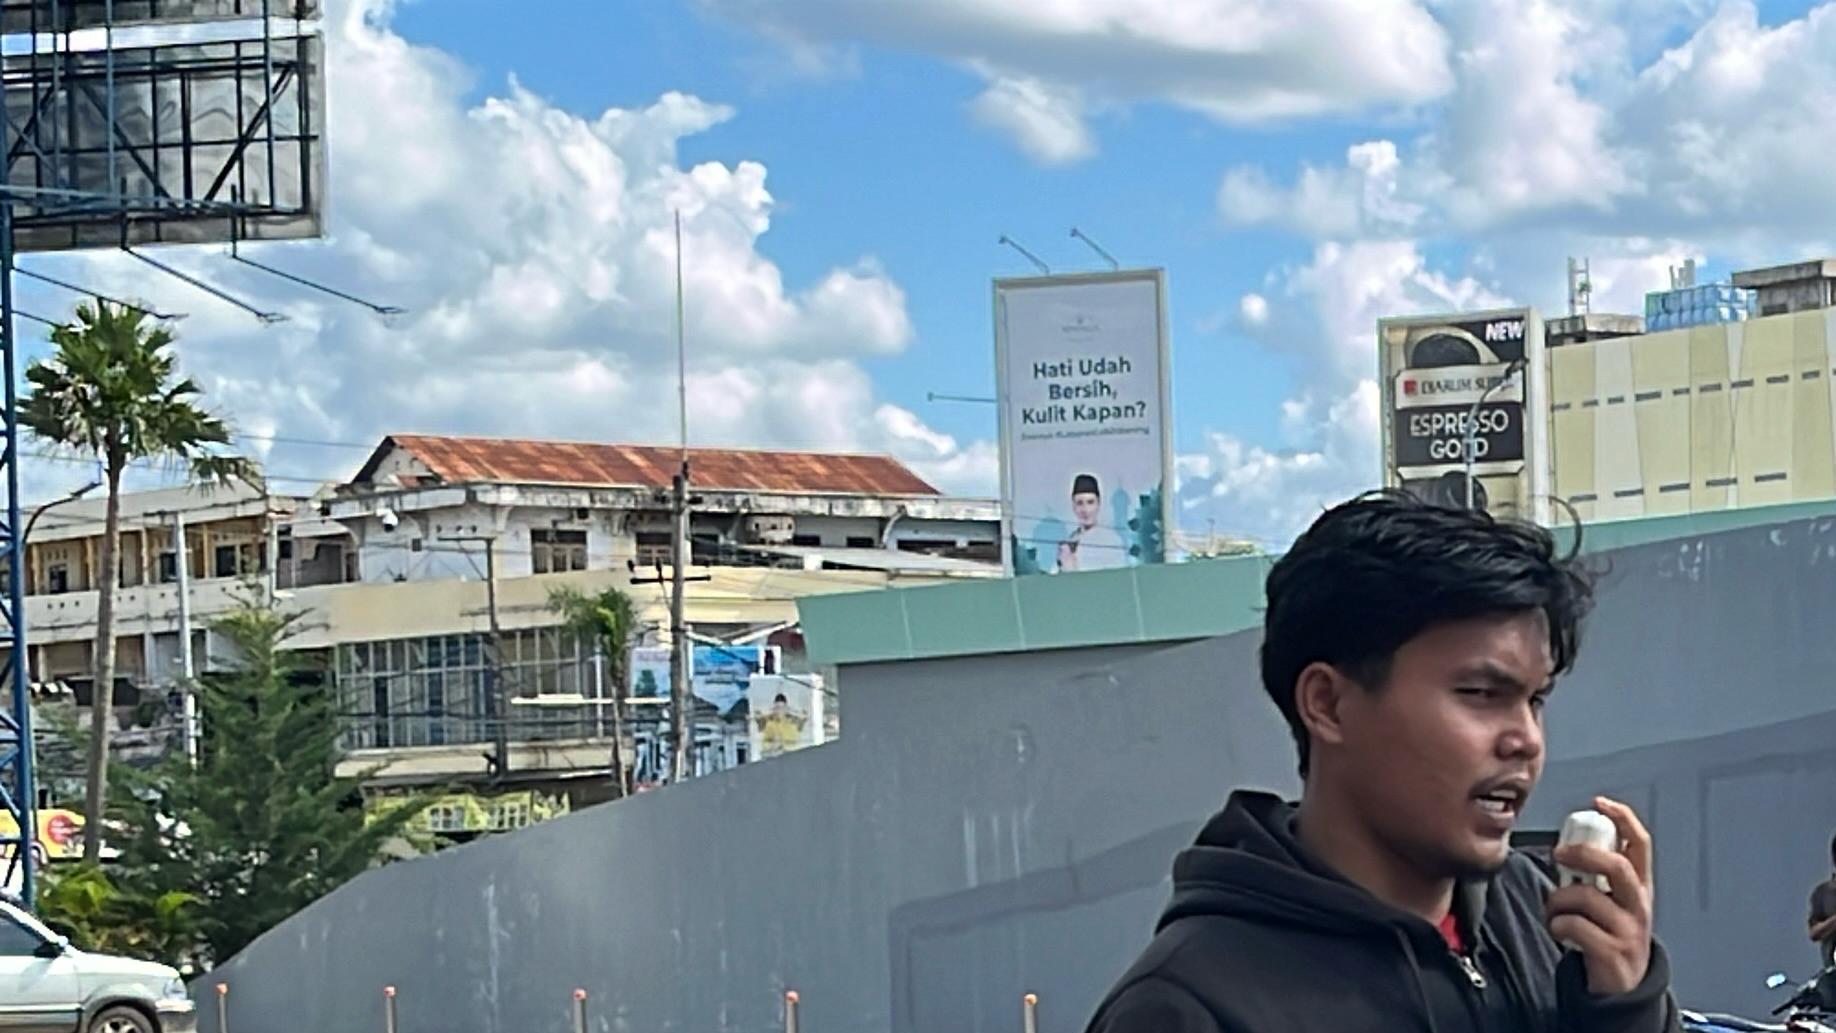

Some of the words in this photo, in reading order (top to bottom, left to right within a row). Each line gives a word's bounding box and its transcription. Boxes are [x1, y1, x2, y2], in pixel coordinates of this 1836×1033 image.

[1485, 320, 1525, 341] NEW
[1032, 357, 1074, 380] Hati
[1078, 355, 1132, 376] Udah
[1048, 378, 1118, 401] Bersih,
[1021, 403, 1067, 425] Kulit
[1072, 400, 1147, 424] Kapan?
[1430, 436, 1489, 459] GOD
